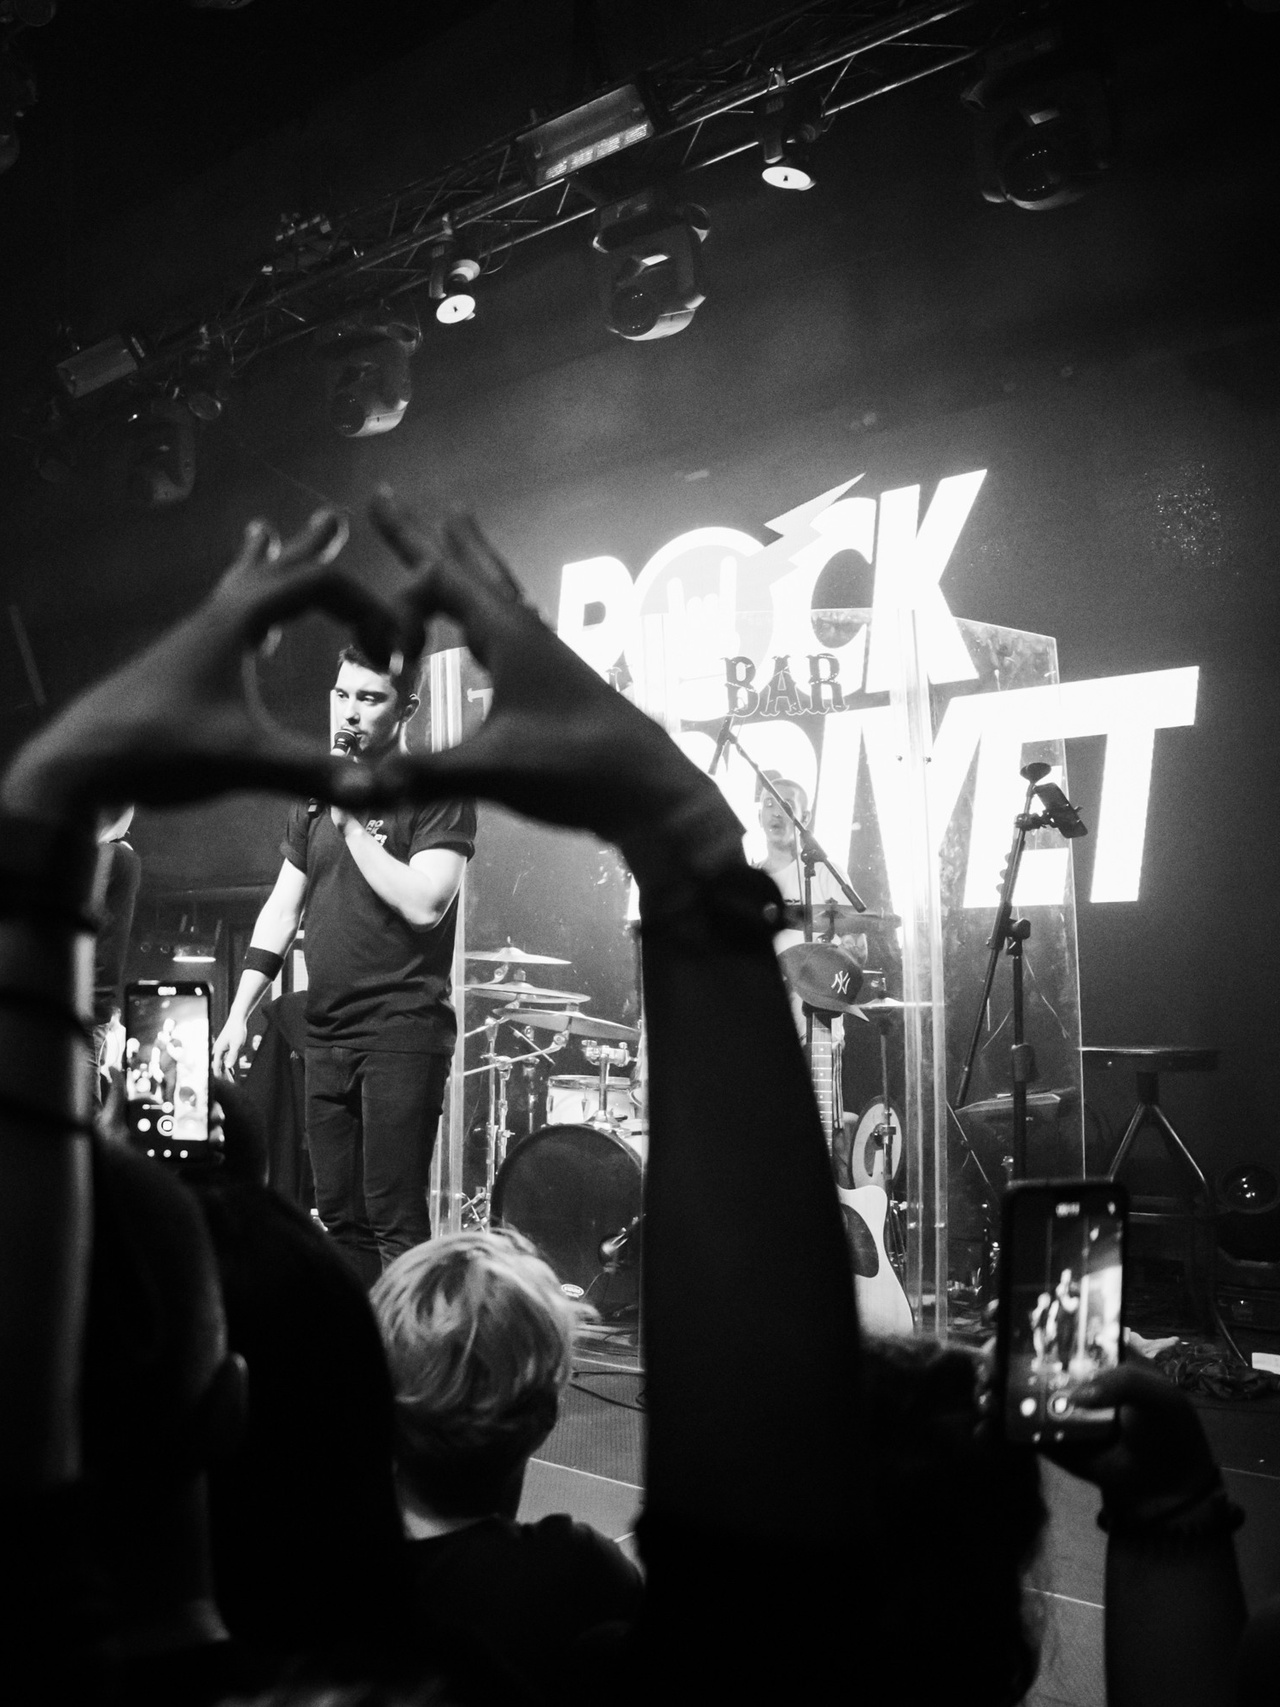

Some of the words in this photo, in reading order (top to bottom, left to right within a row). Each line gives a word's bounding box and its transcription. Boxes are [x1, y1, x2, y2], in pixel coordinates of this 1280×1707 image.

[556, 470, 987, 722] ROCK
[720, 652, 850, 718] BAR
[625, 666, 1200, 946] IVET
